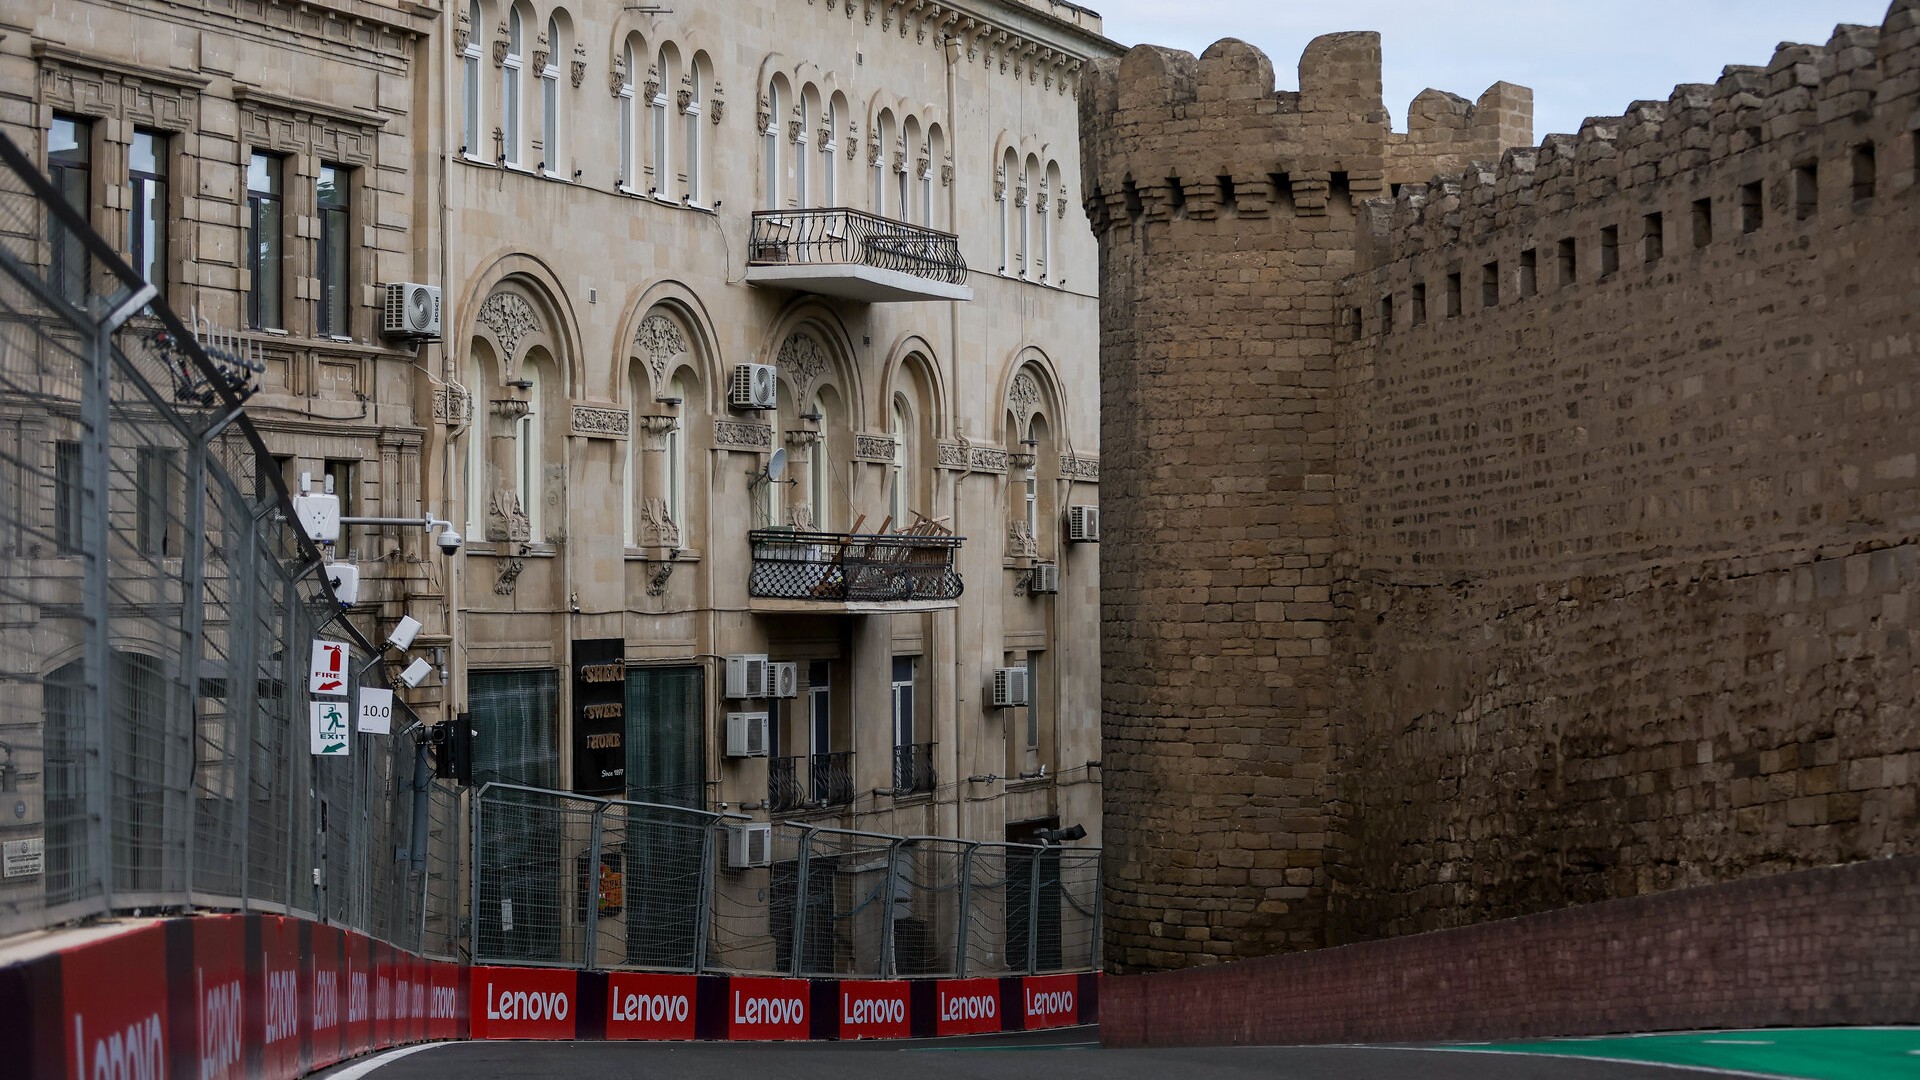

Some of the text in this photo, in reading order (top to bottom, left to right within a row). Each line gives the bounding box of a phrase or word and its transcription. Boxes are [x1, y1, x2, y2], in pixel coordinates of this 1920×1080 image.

[315, 671, 340, 680] FIRE
[363, 704, 390, 719] 10.0
[584, 703, 622, 719] SWEET
[320, 733, 347, 741] EXIT
[587, 734, 620, 749] HOME
[264, 951, 298, 1044] Lenovo
[313, 953, 338, 1031] Lenovo
[348, 956, 368, 1023] Lenovo
[487, 982, 569, 1021] Lenovo
[612, 986, 689, 1022] Lenovo
[1026, 987, 1073, 1016] Lenovo
[735, 990, 804, 1025] Lenovo
[844, 992, 905, 1024] Lenovo
[941, 991, 996, 1022] Lenovo
[198, 967, 242, 1080] Lenovo
